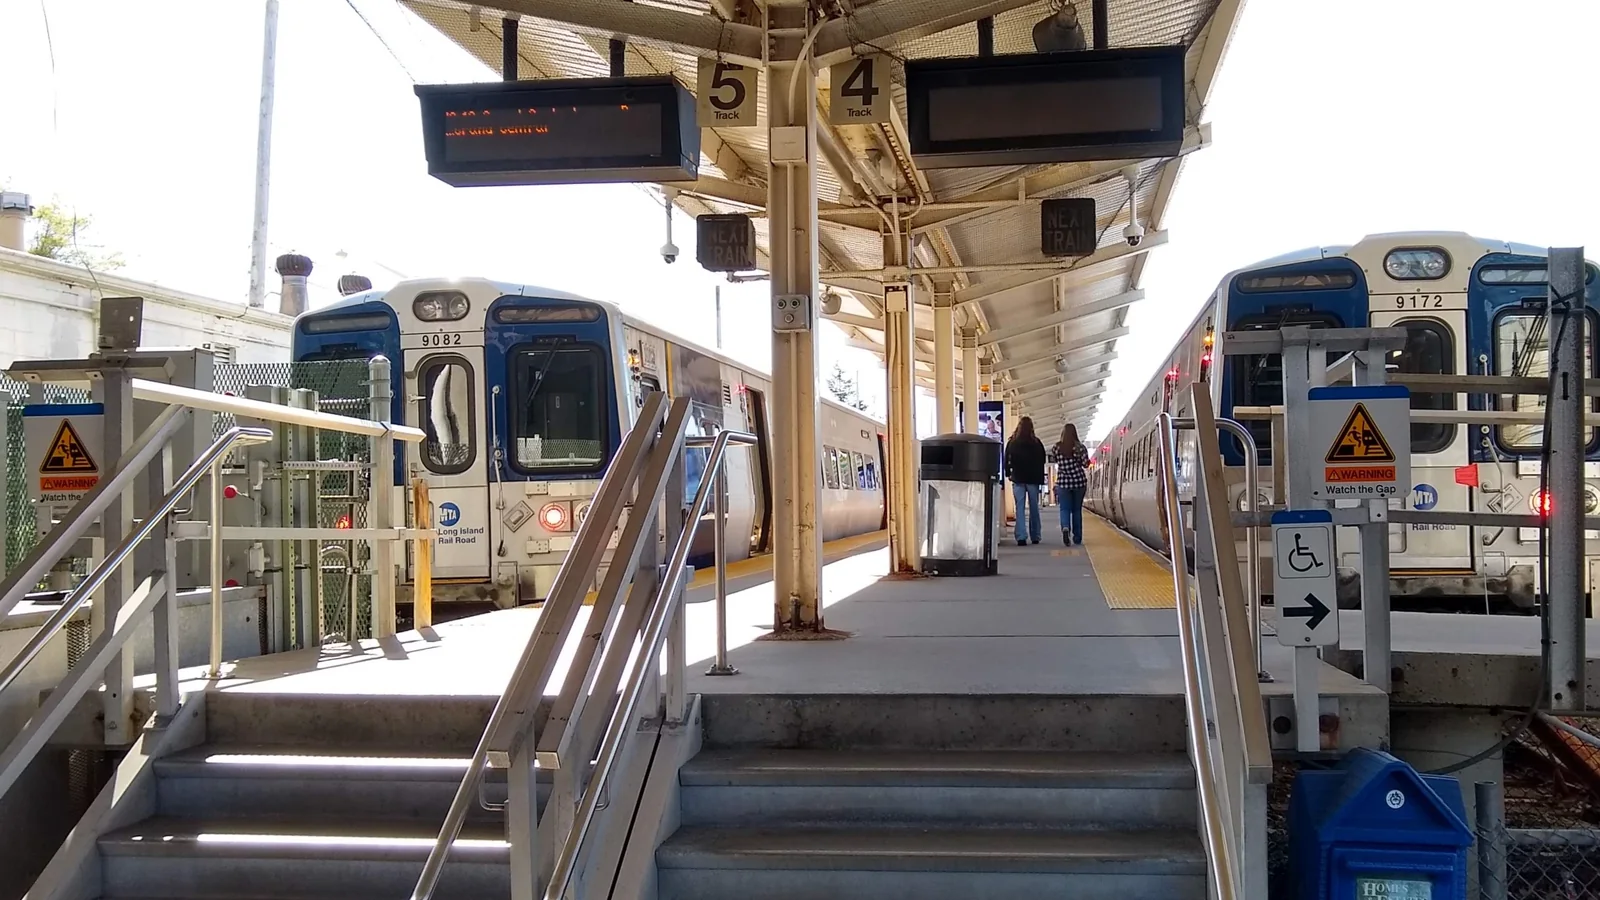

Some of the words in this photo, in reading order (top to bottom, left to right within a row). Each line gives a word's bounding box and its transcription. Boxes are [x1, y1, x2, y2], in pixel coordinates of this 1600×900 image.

[709, 63, 746, 110] 5
[841, 59, 879, 105] 4
[714, 111, 740, 120] Track
[847, 108, 872, 117] Track
[1047, 207, 1089, 228] NEXT
[1045, 229, 1092, 252] TRAIN
[1396, 295, 1442, 309] 9172
[422, 333, 461, 347] 9082
[1341, 469, 1393, 479] WARNING
[1325, 485, 1356, 494] Watch
[1358, 485, 1373, 494] the
[1375, 484, 1396, 495] Gap
[41, 493, 67, 502] Watch
[1413, 490, 1434, 505] MTA
[439, 507, 457, 522] MTA
[1412, 523, 1430, 531] Rail
